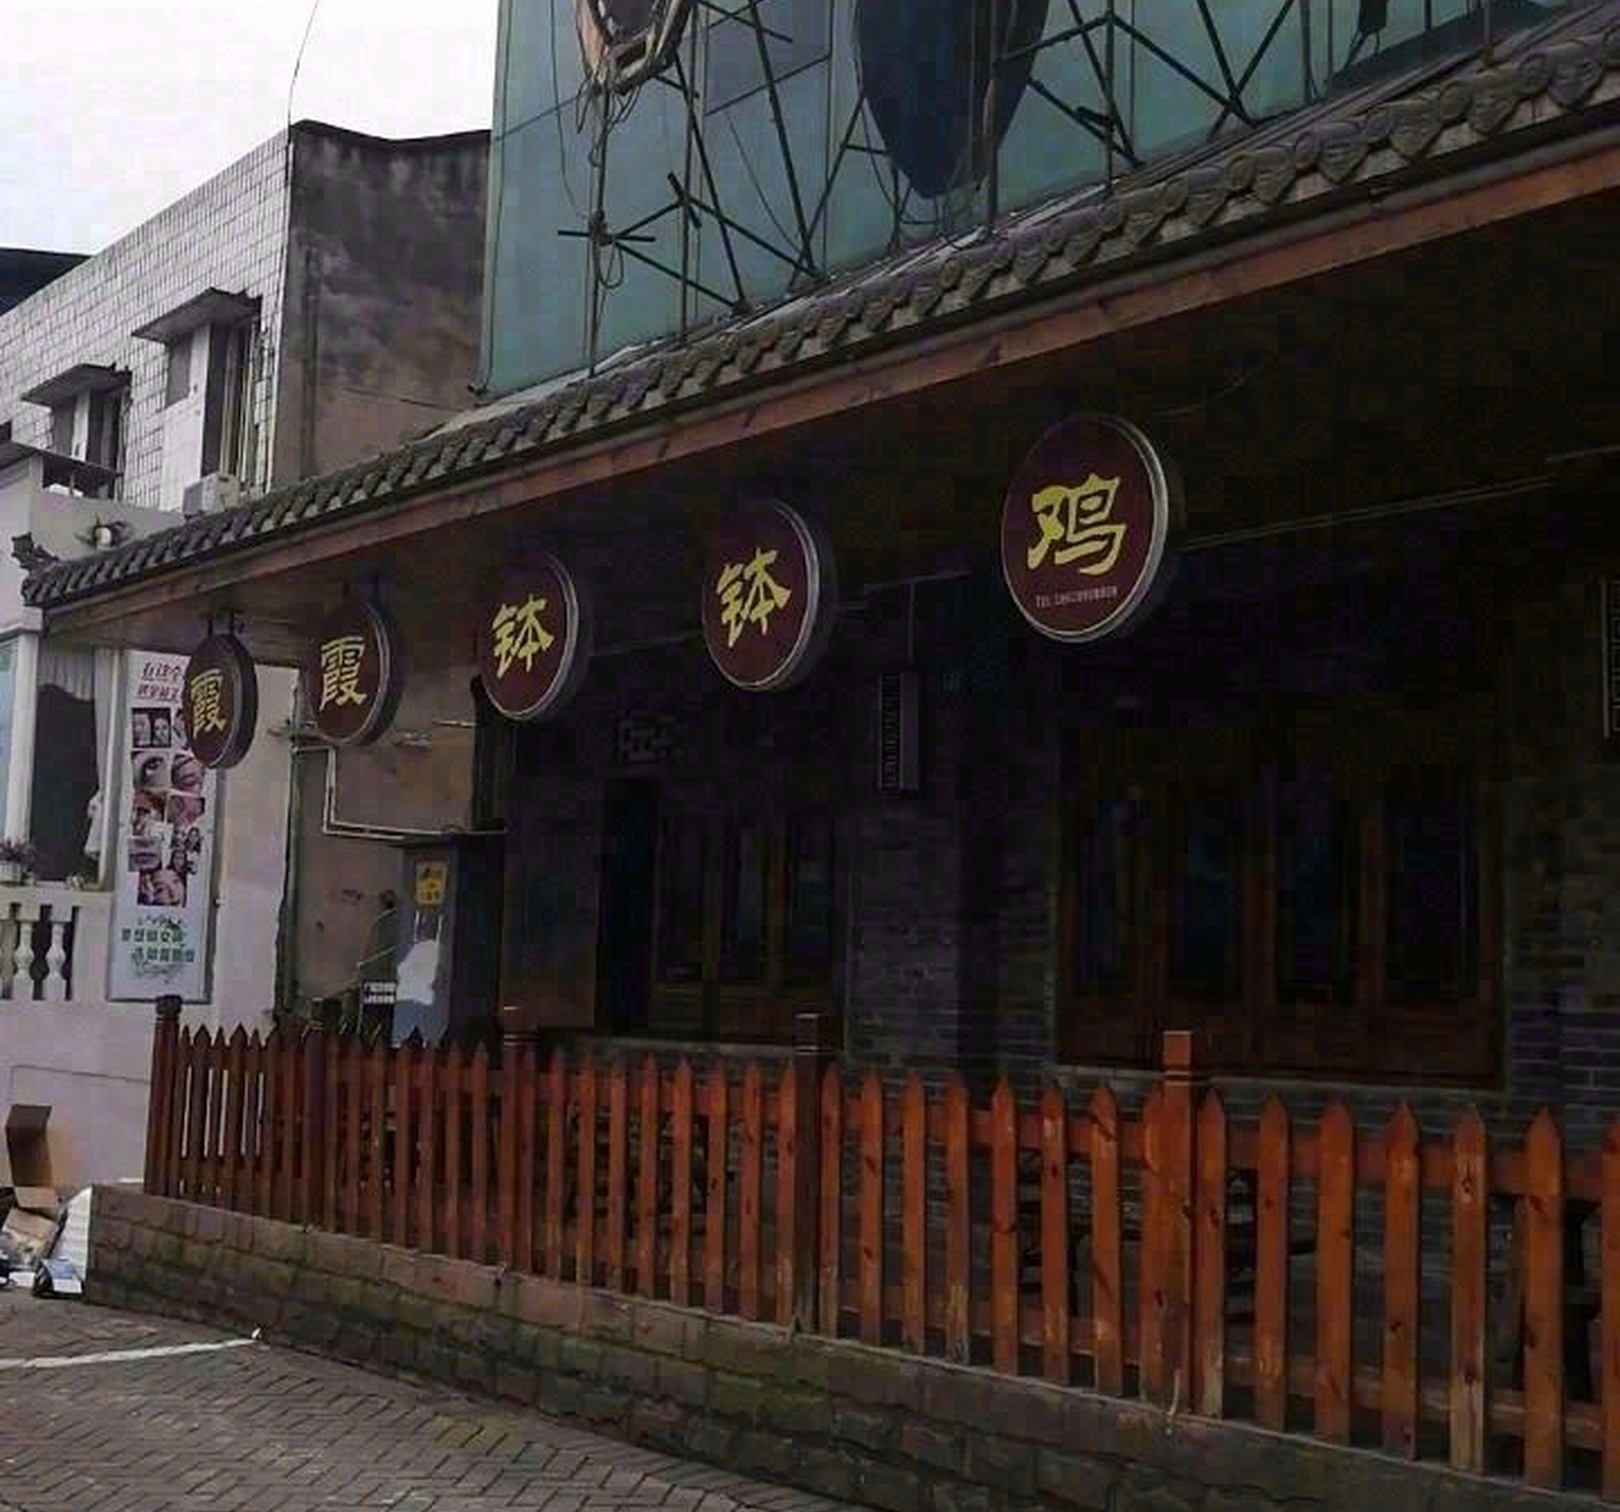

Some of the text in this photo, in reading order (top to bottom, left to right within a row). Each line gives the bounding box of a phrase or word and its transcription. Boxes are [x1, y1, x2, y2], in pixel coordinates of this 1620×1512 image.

[1028, 474, 1126, 576] 鸡
[493, 596, 552, 677] 钵
[717, 548, 790, 646] 钵
[190, 672, 224, 736] 霞
[321, 637, 365, 710] 霞
